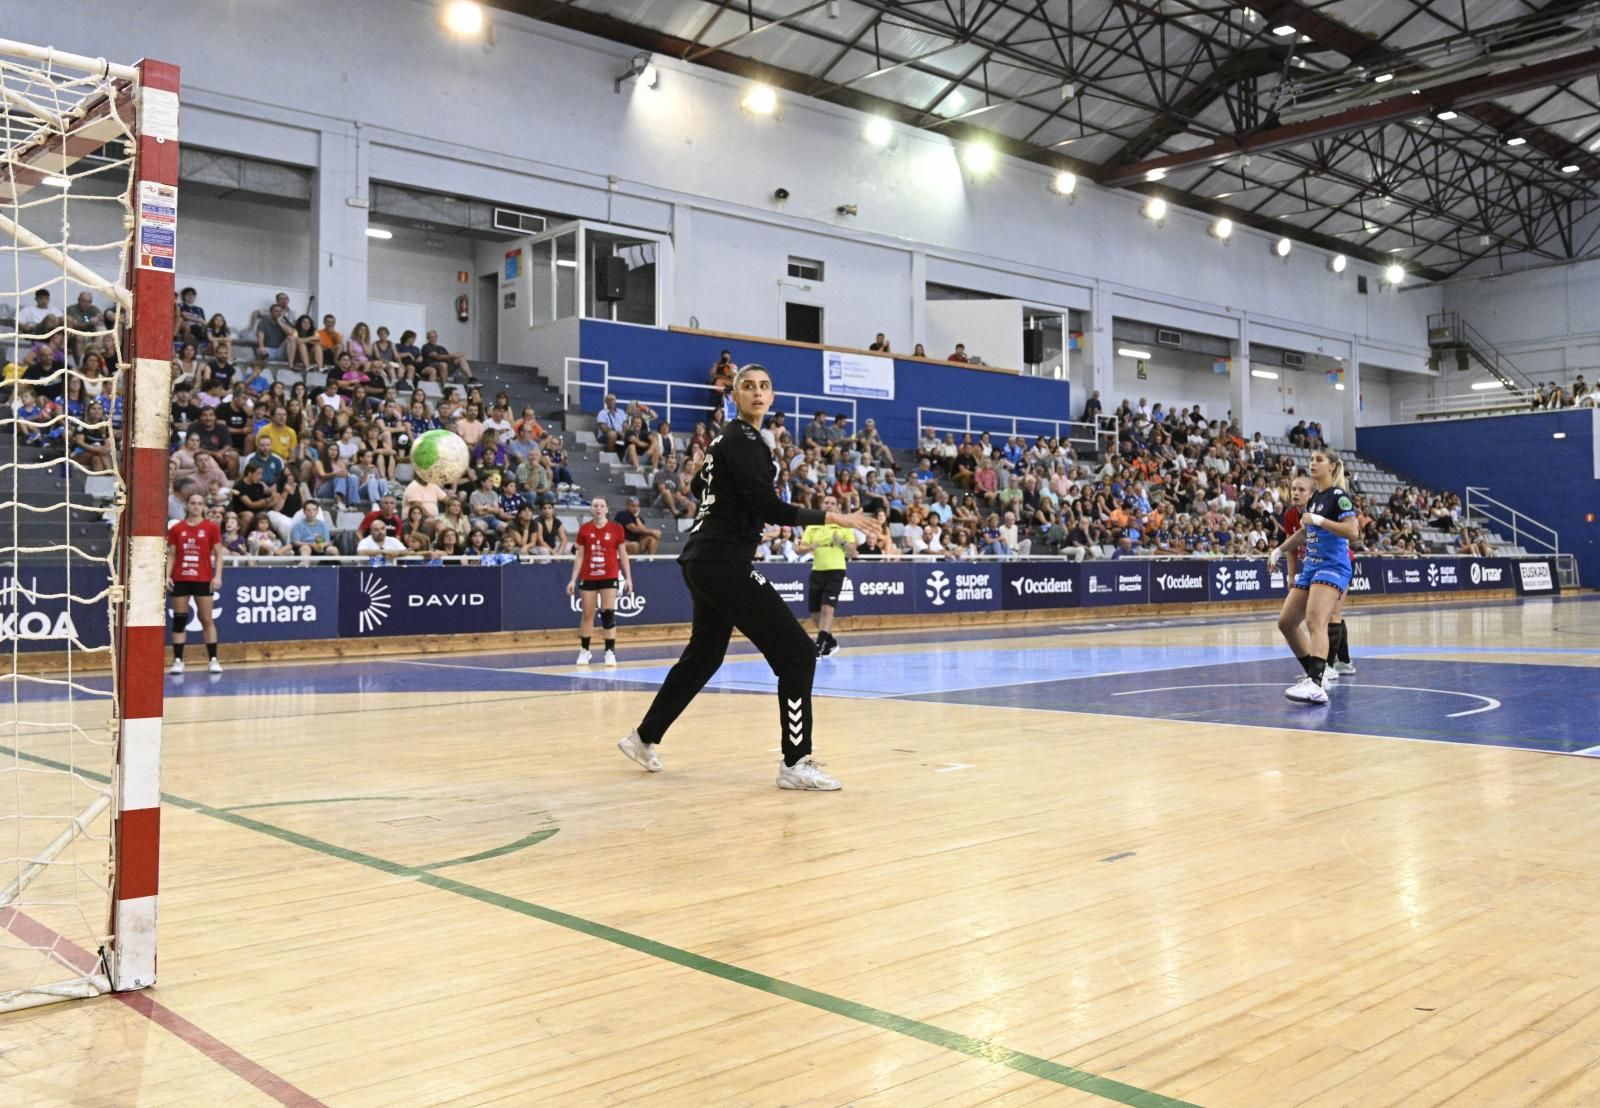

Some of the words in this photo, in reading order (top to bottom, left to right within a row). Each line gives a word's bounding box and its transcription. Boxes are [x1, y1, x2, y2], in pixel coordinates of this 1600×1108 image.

[955, 574, 990, 589] super
[1166, 574, 1203, 589] Occident
[1234, 569, 1258, 581] super
[1024, 577, 1073, 594] Occident
[1234, 579, 1260, 591] amara
[236, 585, 311, 606] super
[408, 593, 485, 607] DAVID
[955, 587, 993, 600] amara
[235, 604, 317, 624] amara
